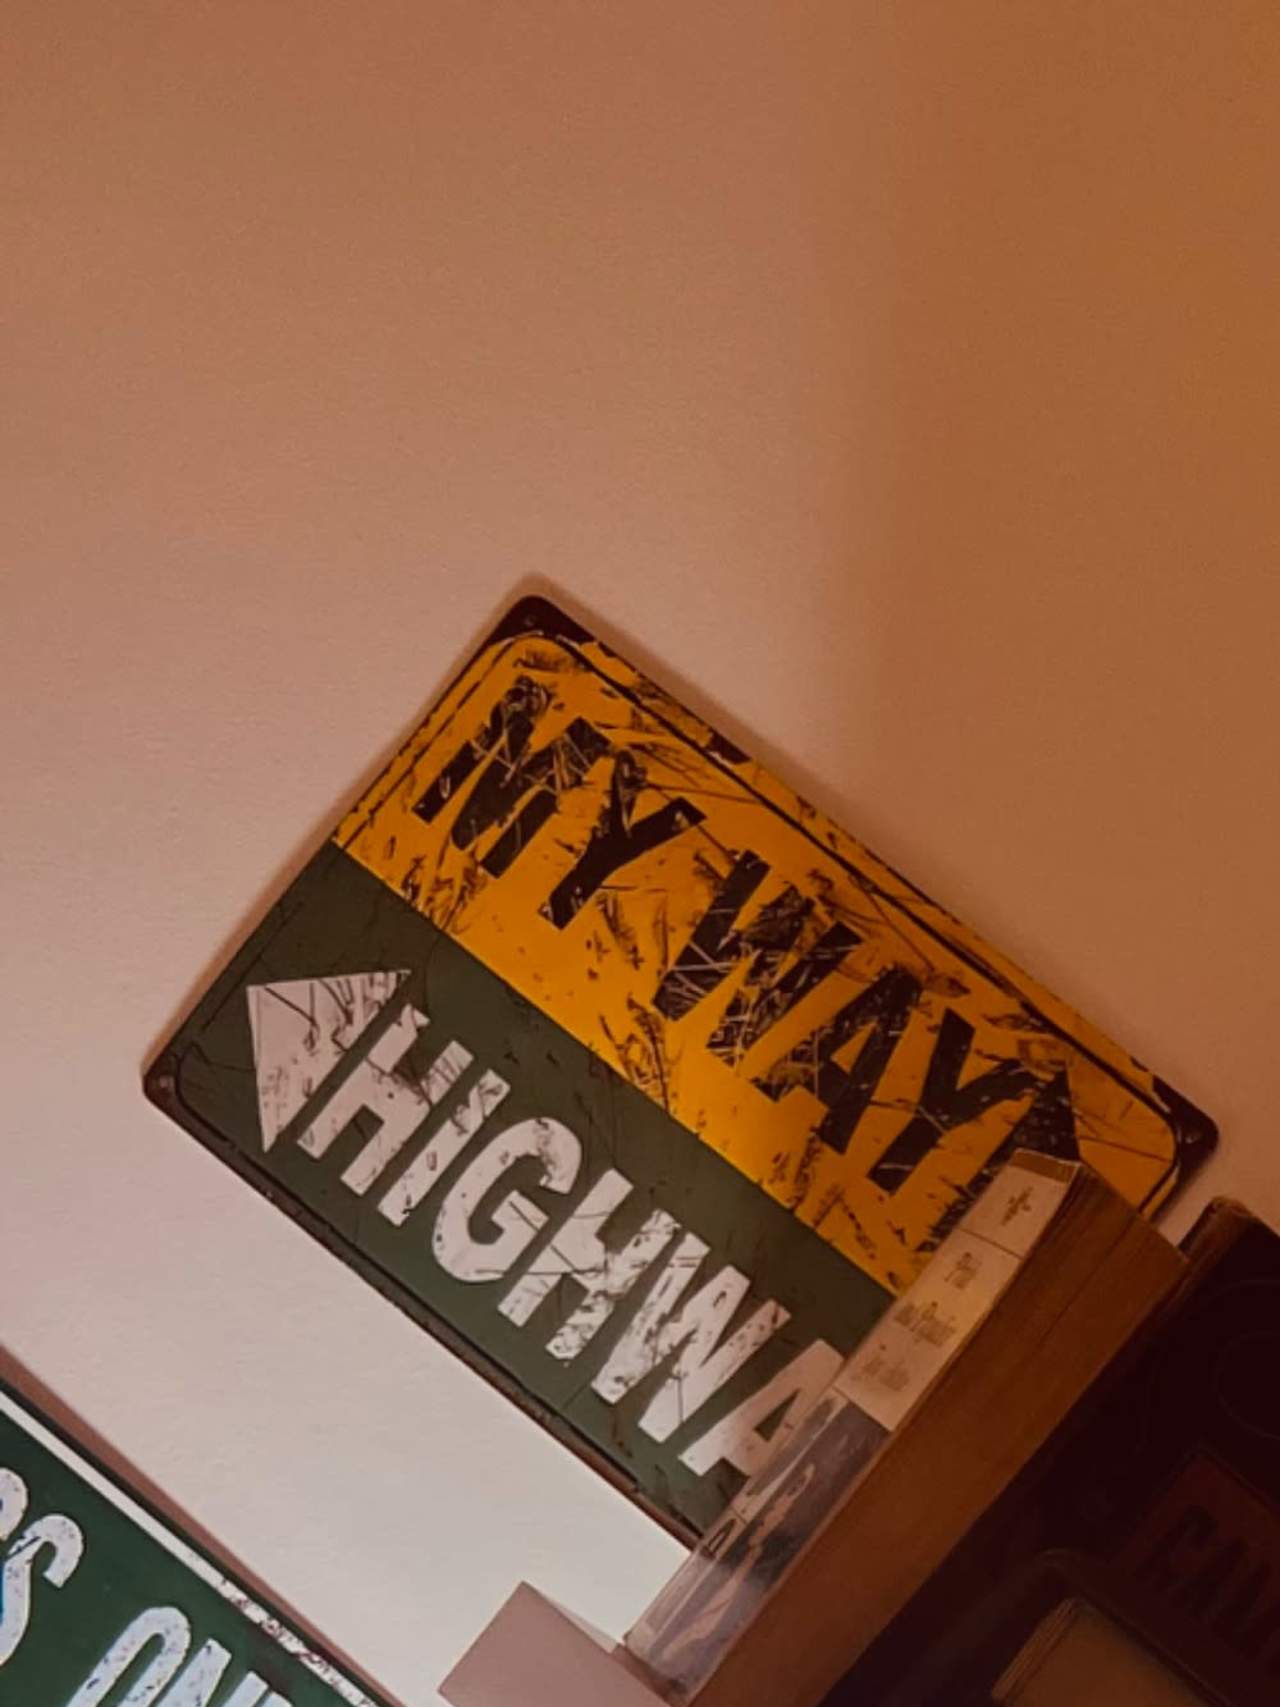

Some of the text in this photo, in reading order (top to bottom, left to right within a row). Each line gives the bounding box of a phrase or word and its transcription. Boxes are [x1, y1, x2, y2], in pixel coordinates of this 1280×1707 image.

[410, 672, 1040, 1194] MY WAY
[294, 1003, 849, 1479] HIGHWA
